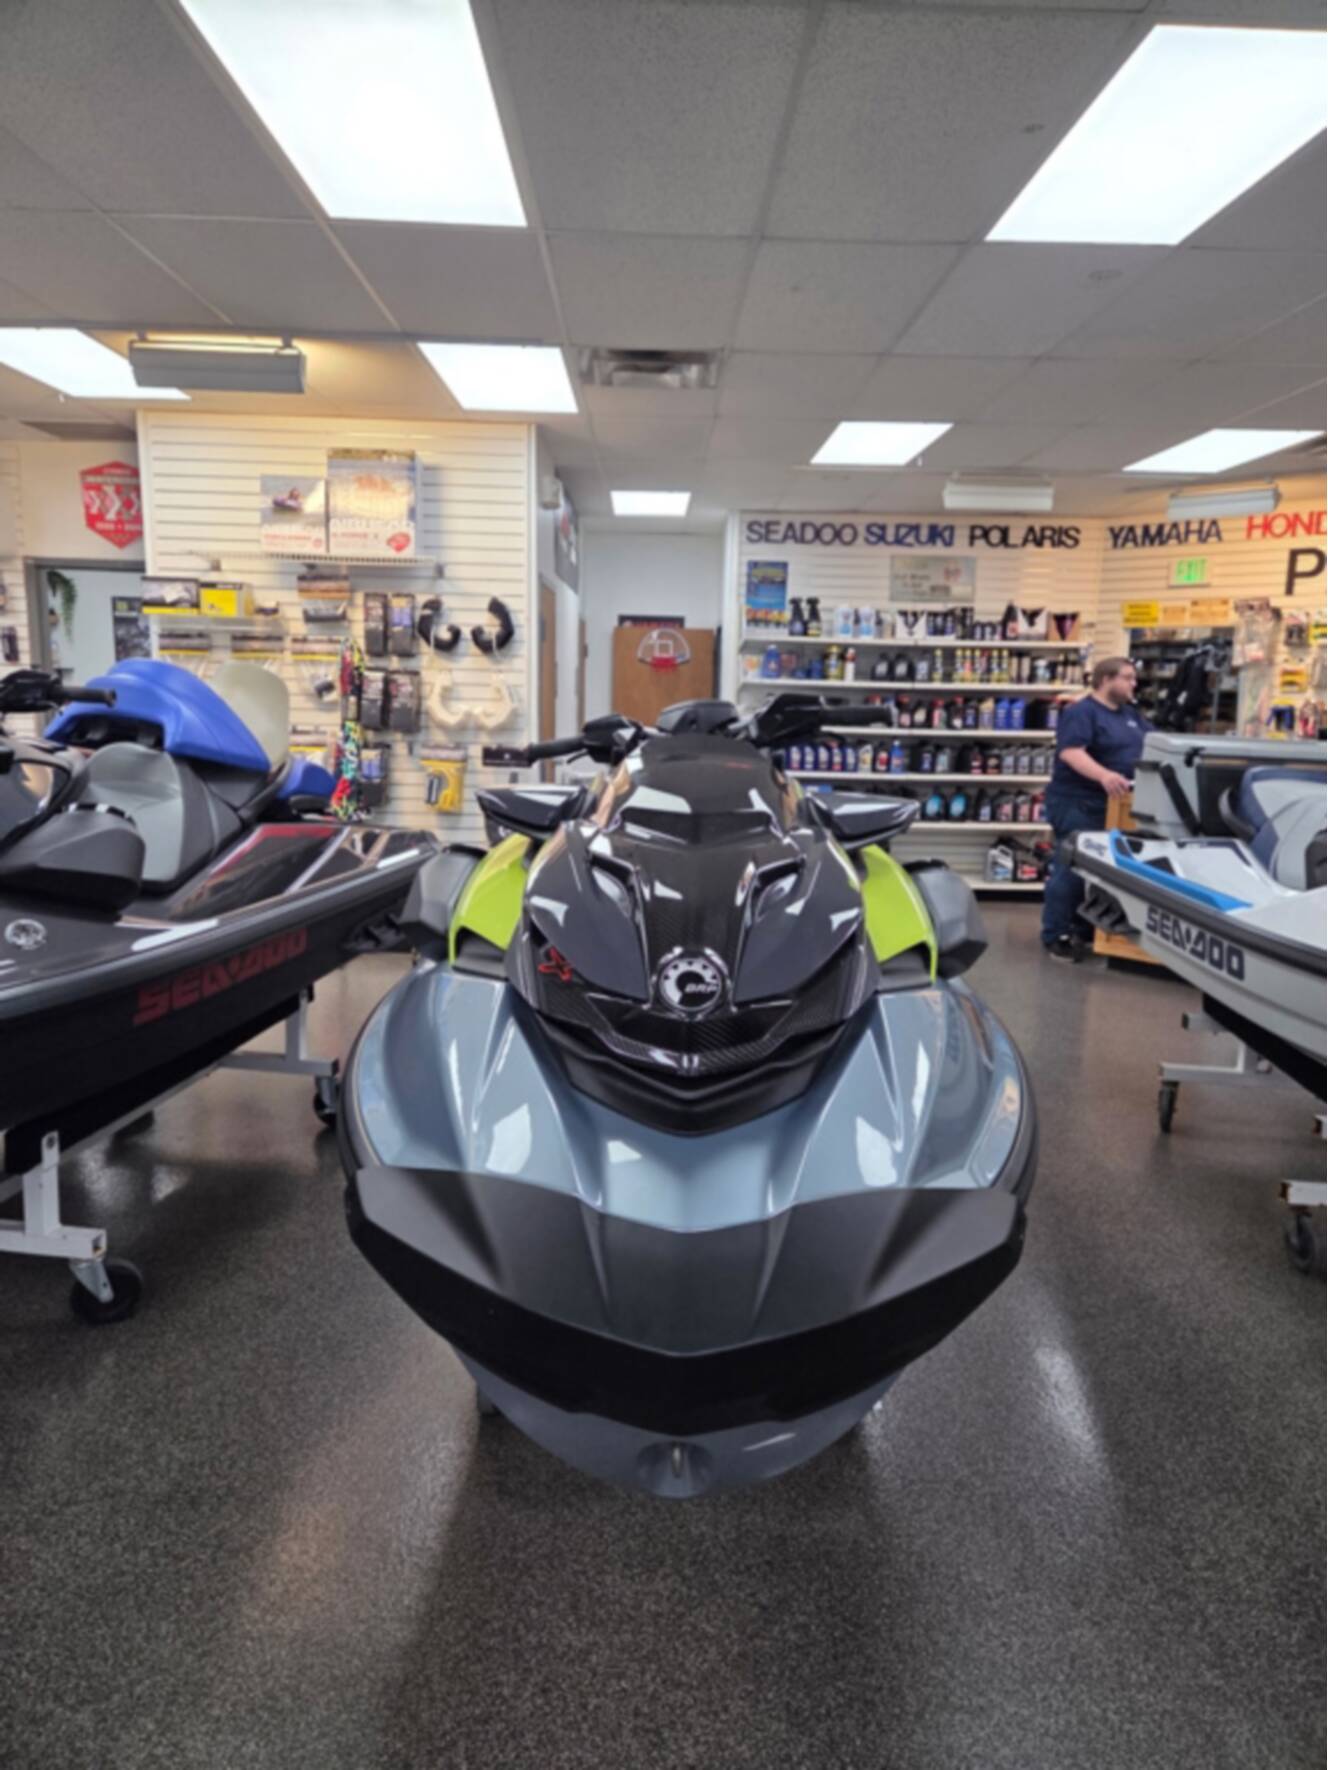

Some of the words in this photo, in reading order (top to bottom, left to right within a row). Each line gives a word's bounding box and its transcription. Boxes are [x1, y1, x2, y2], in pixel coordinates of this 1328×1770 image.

[746, 520, 858, 546] SEADOO
[864, 522, 955, 548] SUZUKI
[968, 524, 1081, 549] POLARIS
[1108, 519, 1223, 549] YAMAHA
[1175, 558, 1208, 582] EXIT
